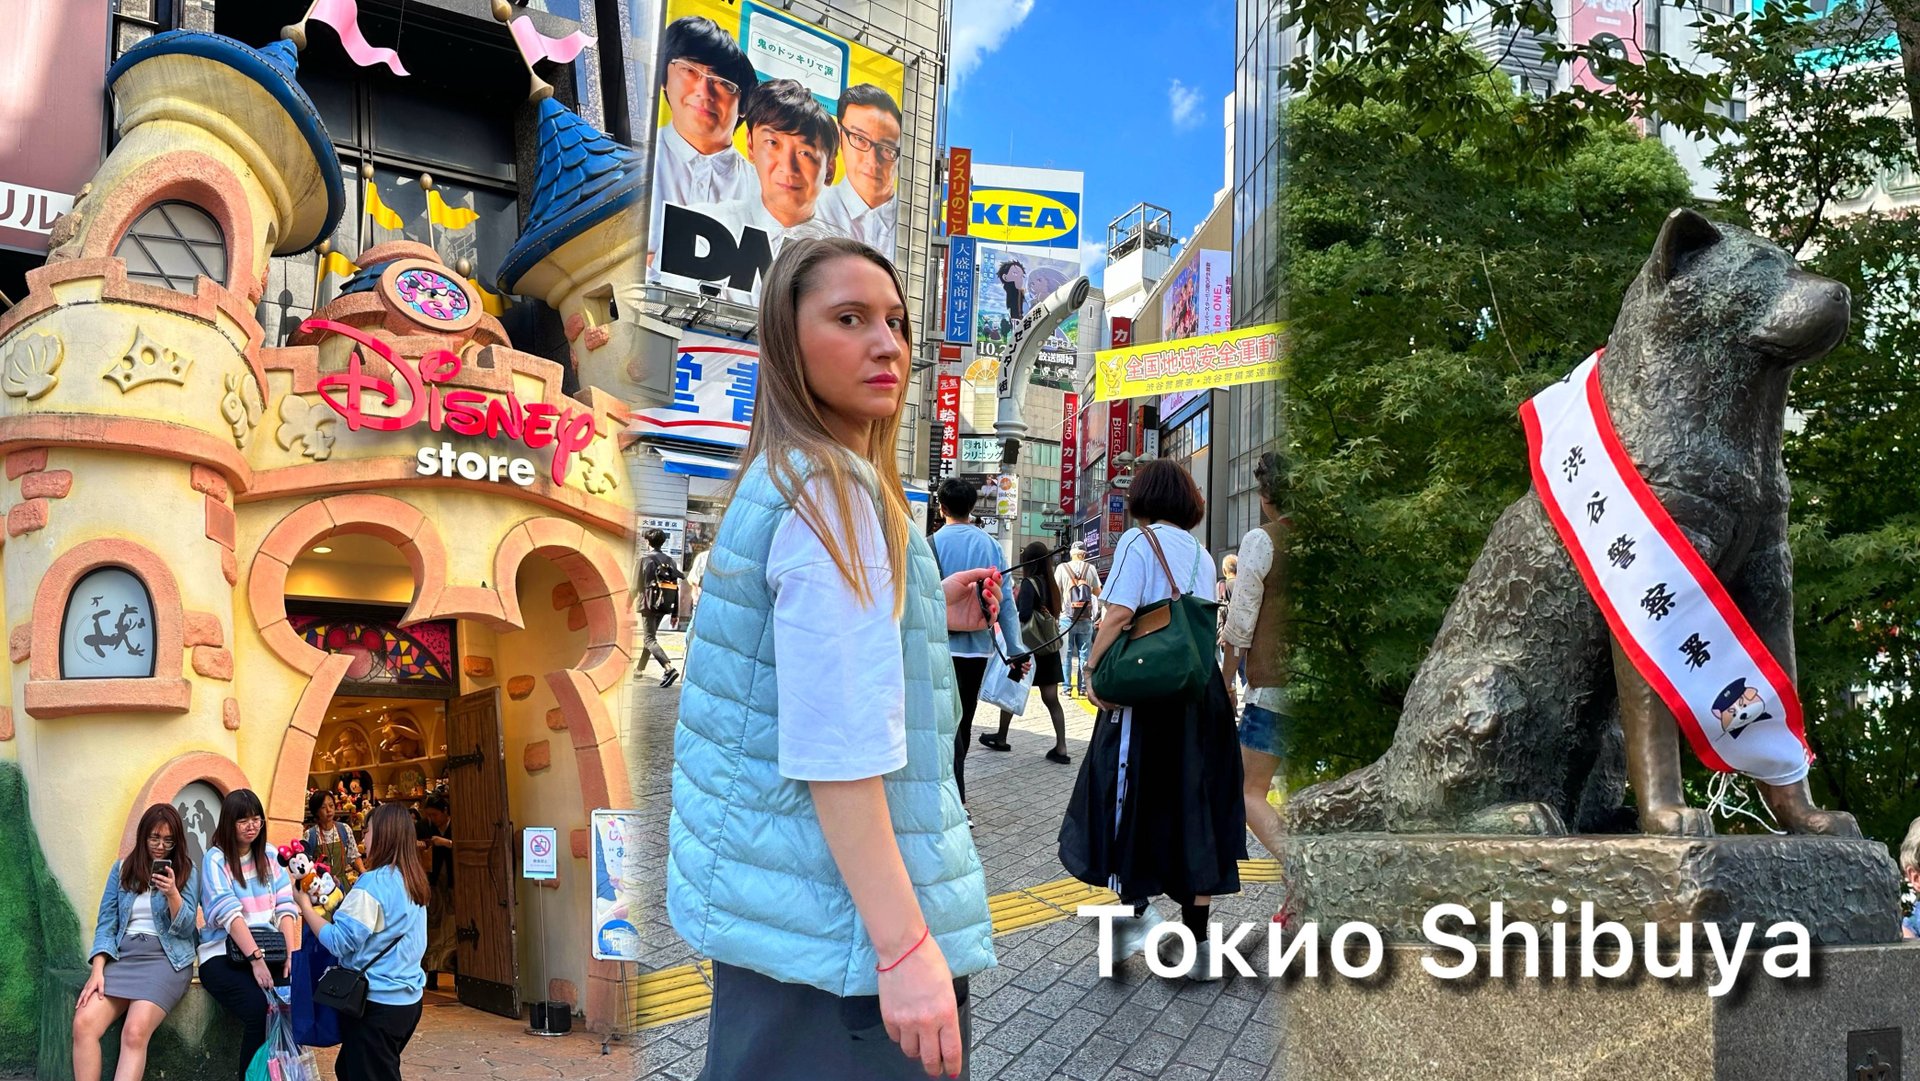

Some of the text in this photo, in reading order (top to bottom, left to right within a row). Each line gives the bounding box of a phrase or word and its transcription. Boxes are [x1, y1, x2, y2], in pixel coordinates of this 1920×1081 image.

[970, 202, 1067, 231] KEA
[953, 243, 970, 337] 大盛堂商事ビル
[998, 306, 1043, 394] 渋谷センター街
[1038, 351, 1074, 366] 放送開始
[416, 442, 536, 486] store
[1062, 446, 1075, 506] カラオケ
[1561, 445, 1712, 673] 渋谷警察署
